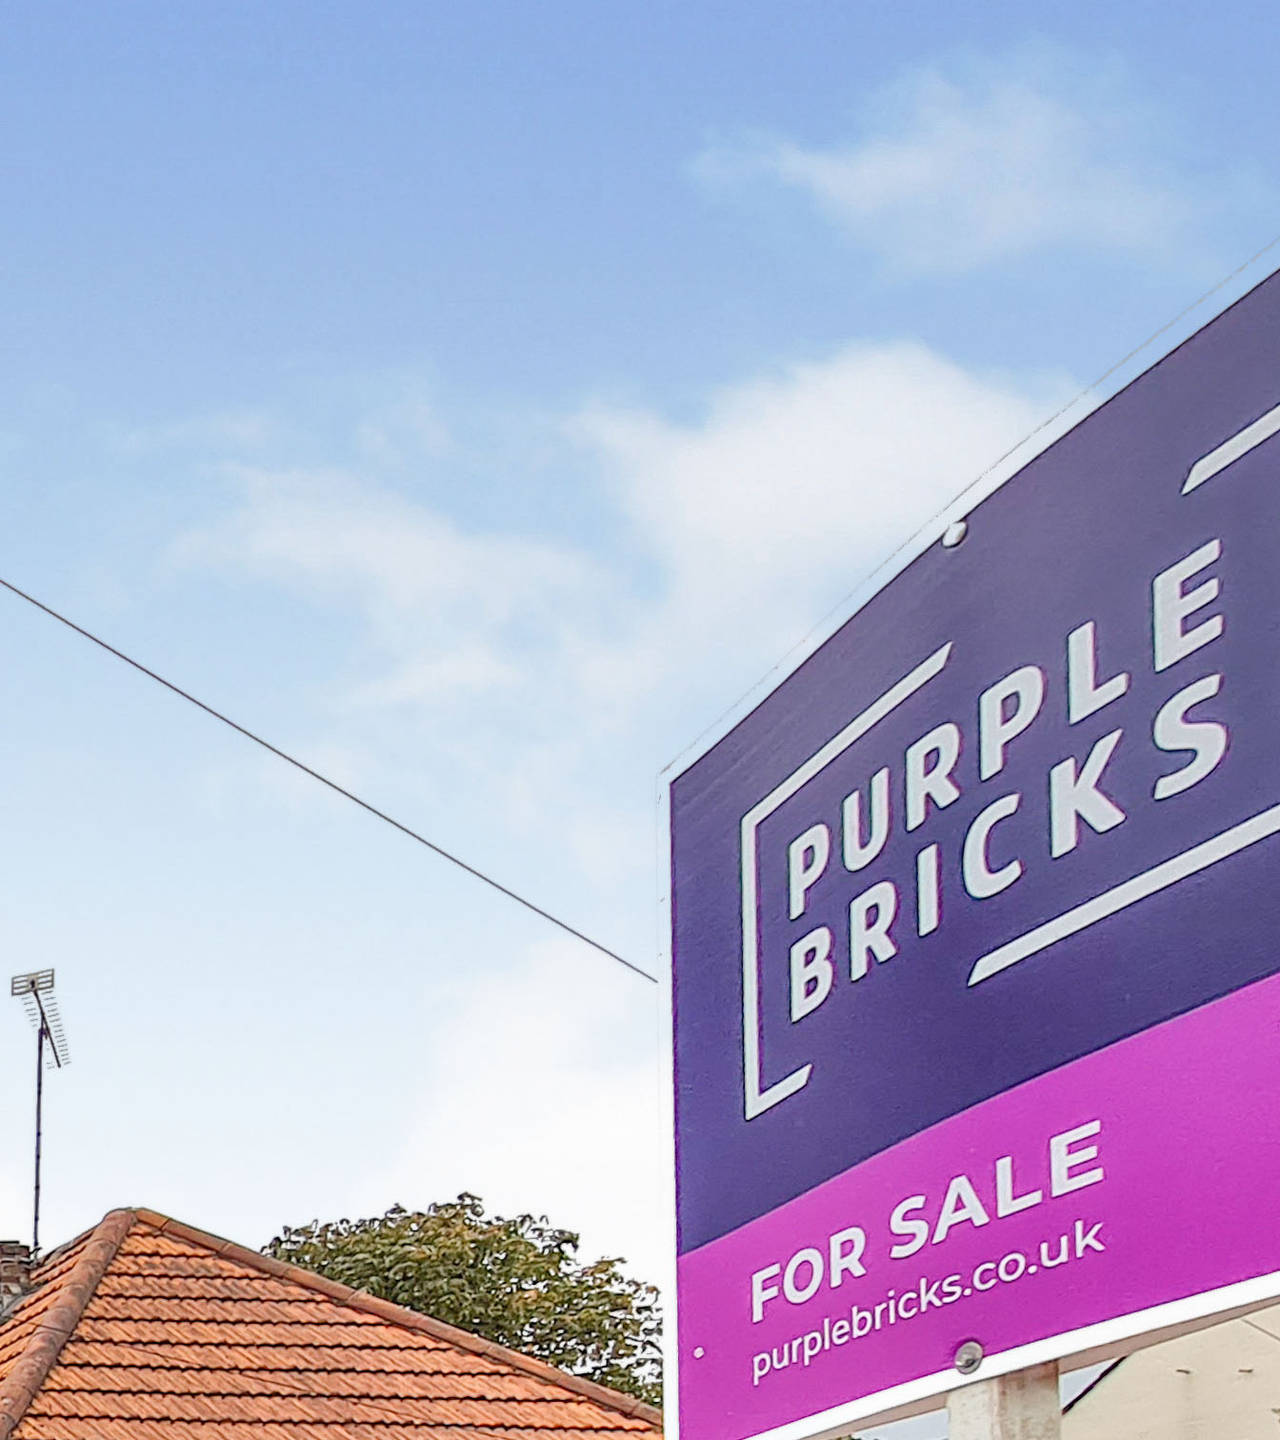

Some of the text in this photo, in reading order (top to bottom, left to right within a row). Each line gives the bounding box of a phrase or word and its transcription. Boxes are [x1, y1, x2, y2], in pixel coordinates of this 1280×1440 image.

[788, 537, 1224, 921] PURPLE
[789, 673, 1229, 1024] BRICKS
[750, 1119, 1105, 1324] FOR SALE
[751, 1219, 1106, 1386] purplebricks.co.uk
